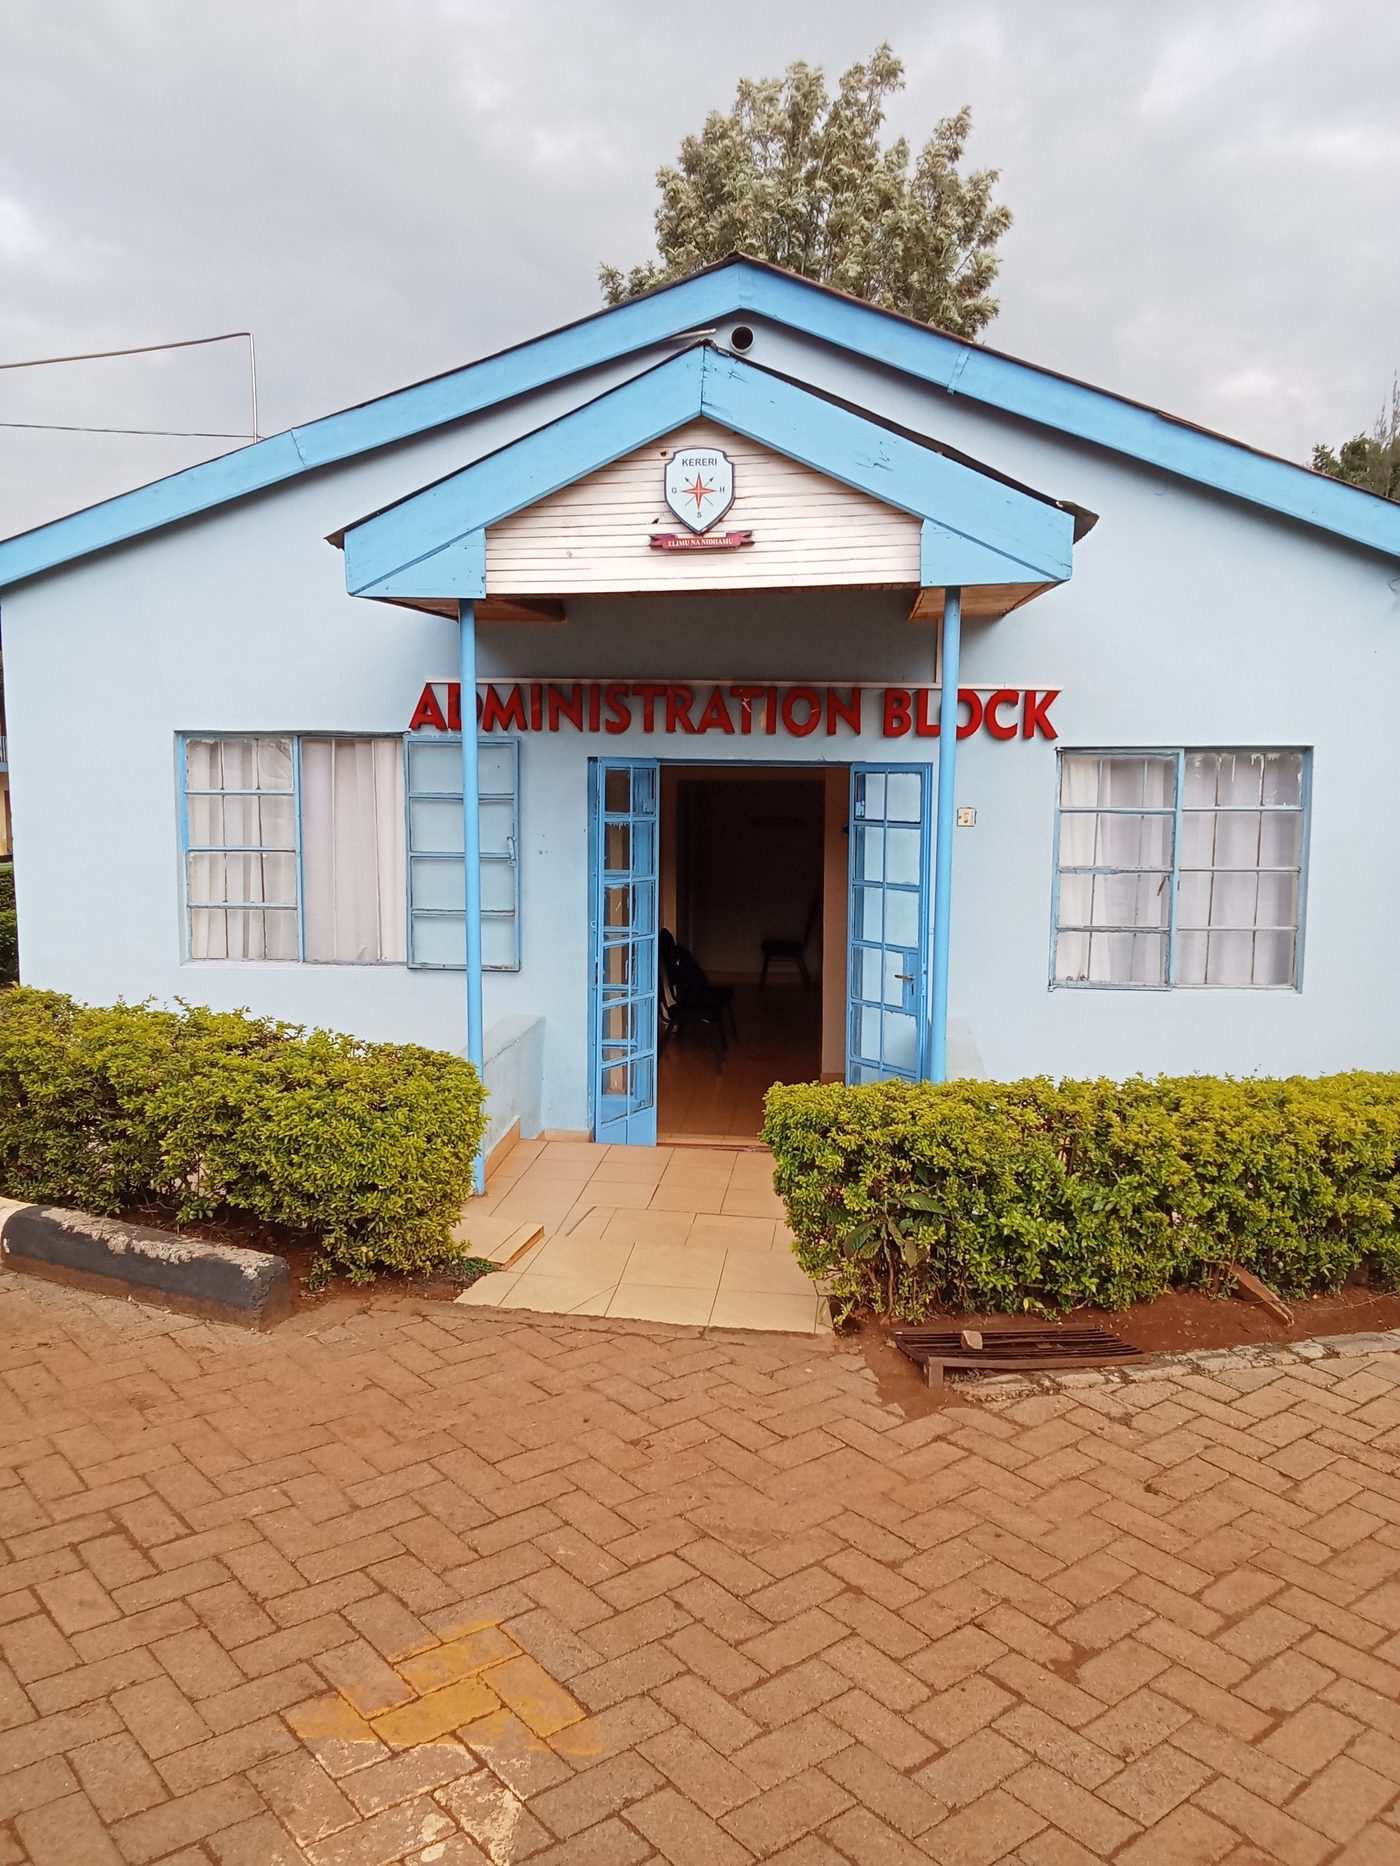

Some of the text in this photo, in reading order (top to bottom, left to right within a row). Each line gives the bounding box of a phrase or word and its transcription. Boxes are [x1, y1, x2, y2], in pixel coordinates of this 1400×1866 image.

[681, 458, 718, 467] KERERI
[667, 537, 734, 547] ELIMU NA NIDHAMU
[882, 687, 1062, 741] BLOCK
